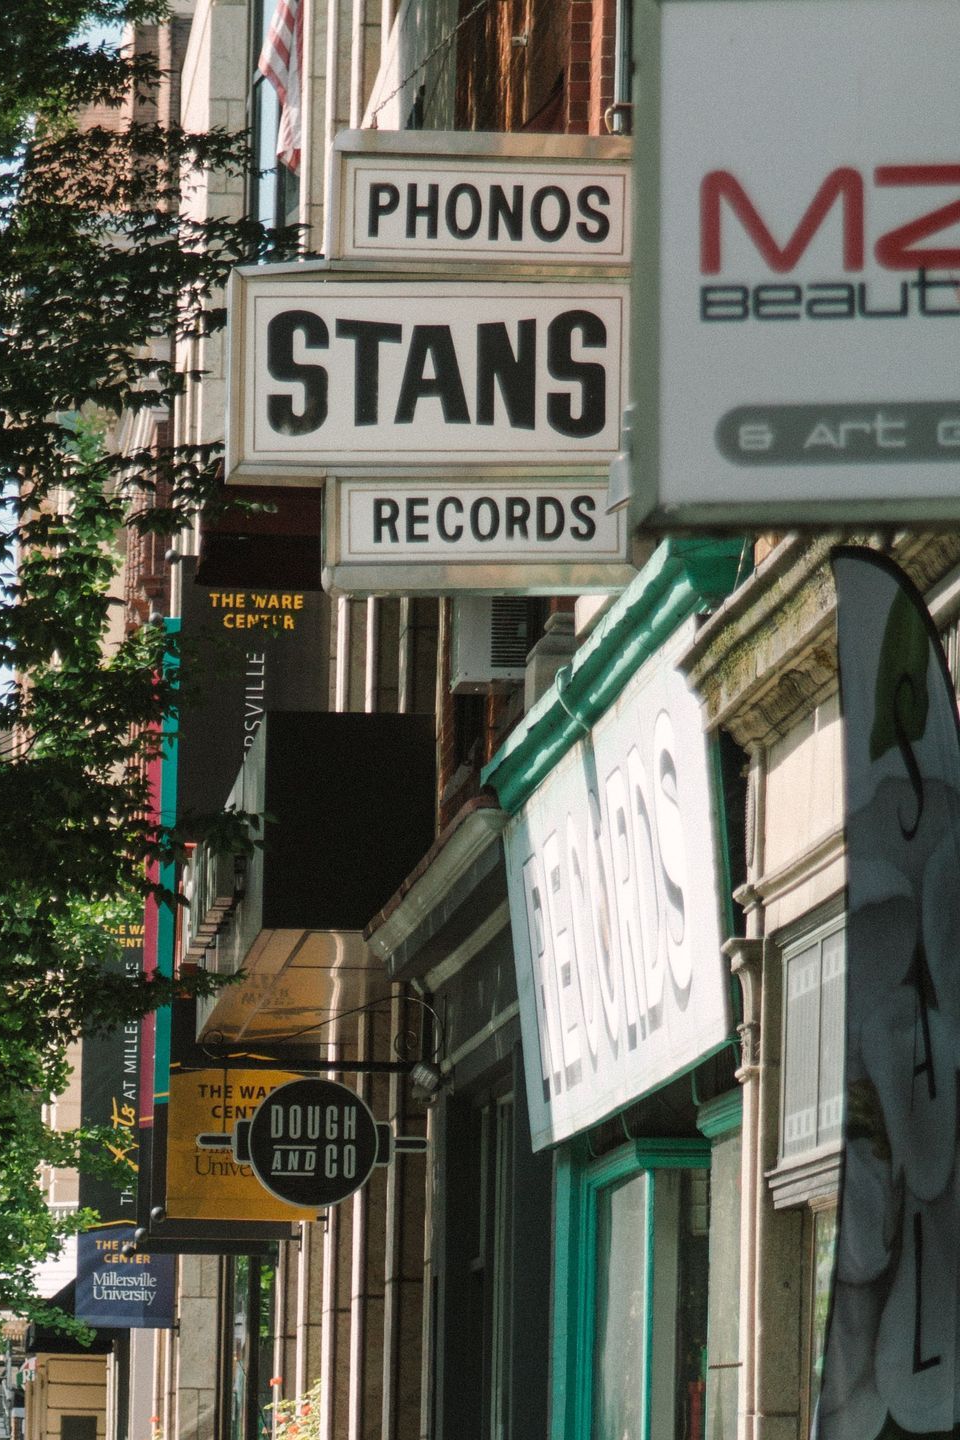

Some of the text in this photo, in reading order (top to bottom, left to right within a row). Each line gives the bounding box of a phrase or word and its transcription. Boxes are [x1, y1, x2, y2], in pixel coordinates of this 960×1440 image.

[367, 183, 610, 243] PHONOS
[267, 310, 607, 438] STANS
[804, 413, 907, 450] Art
[373, 495, 597, 543] RECORDS
[209, 593, 245, 608] THE
[123, 1080, 137, 1100] AT
[198, 1084, 233, 1099] THE
[271, 1105, 357, 1140] DOUGH
[271, 1144, 357, 1179] AND CO
[96, 1240, 119, 1251] THE
[92, 1271, 157, 1287] Millersville
[92, 1286, 157, 1306] University
